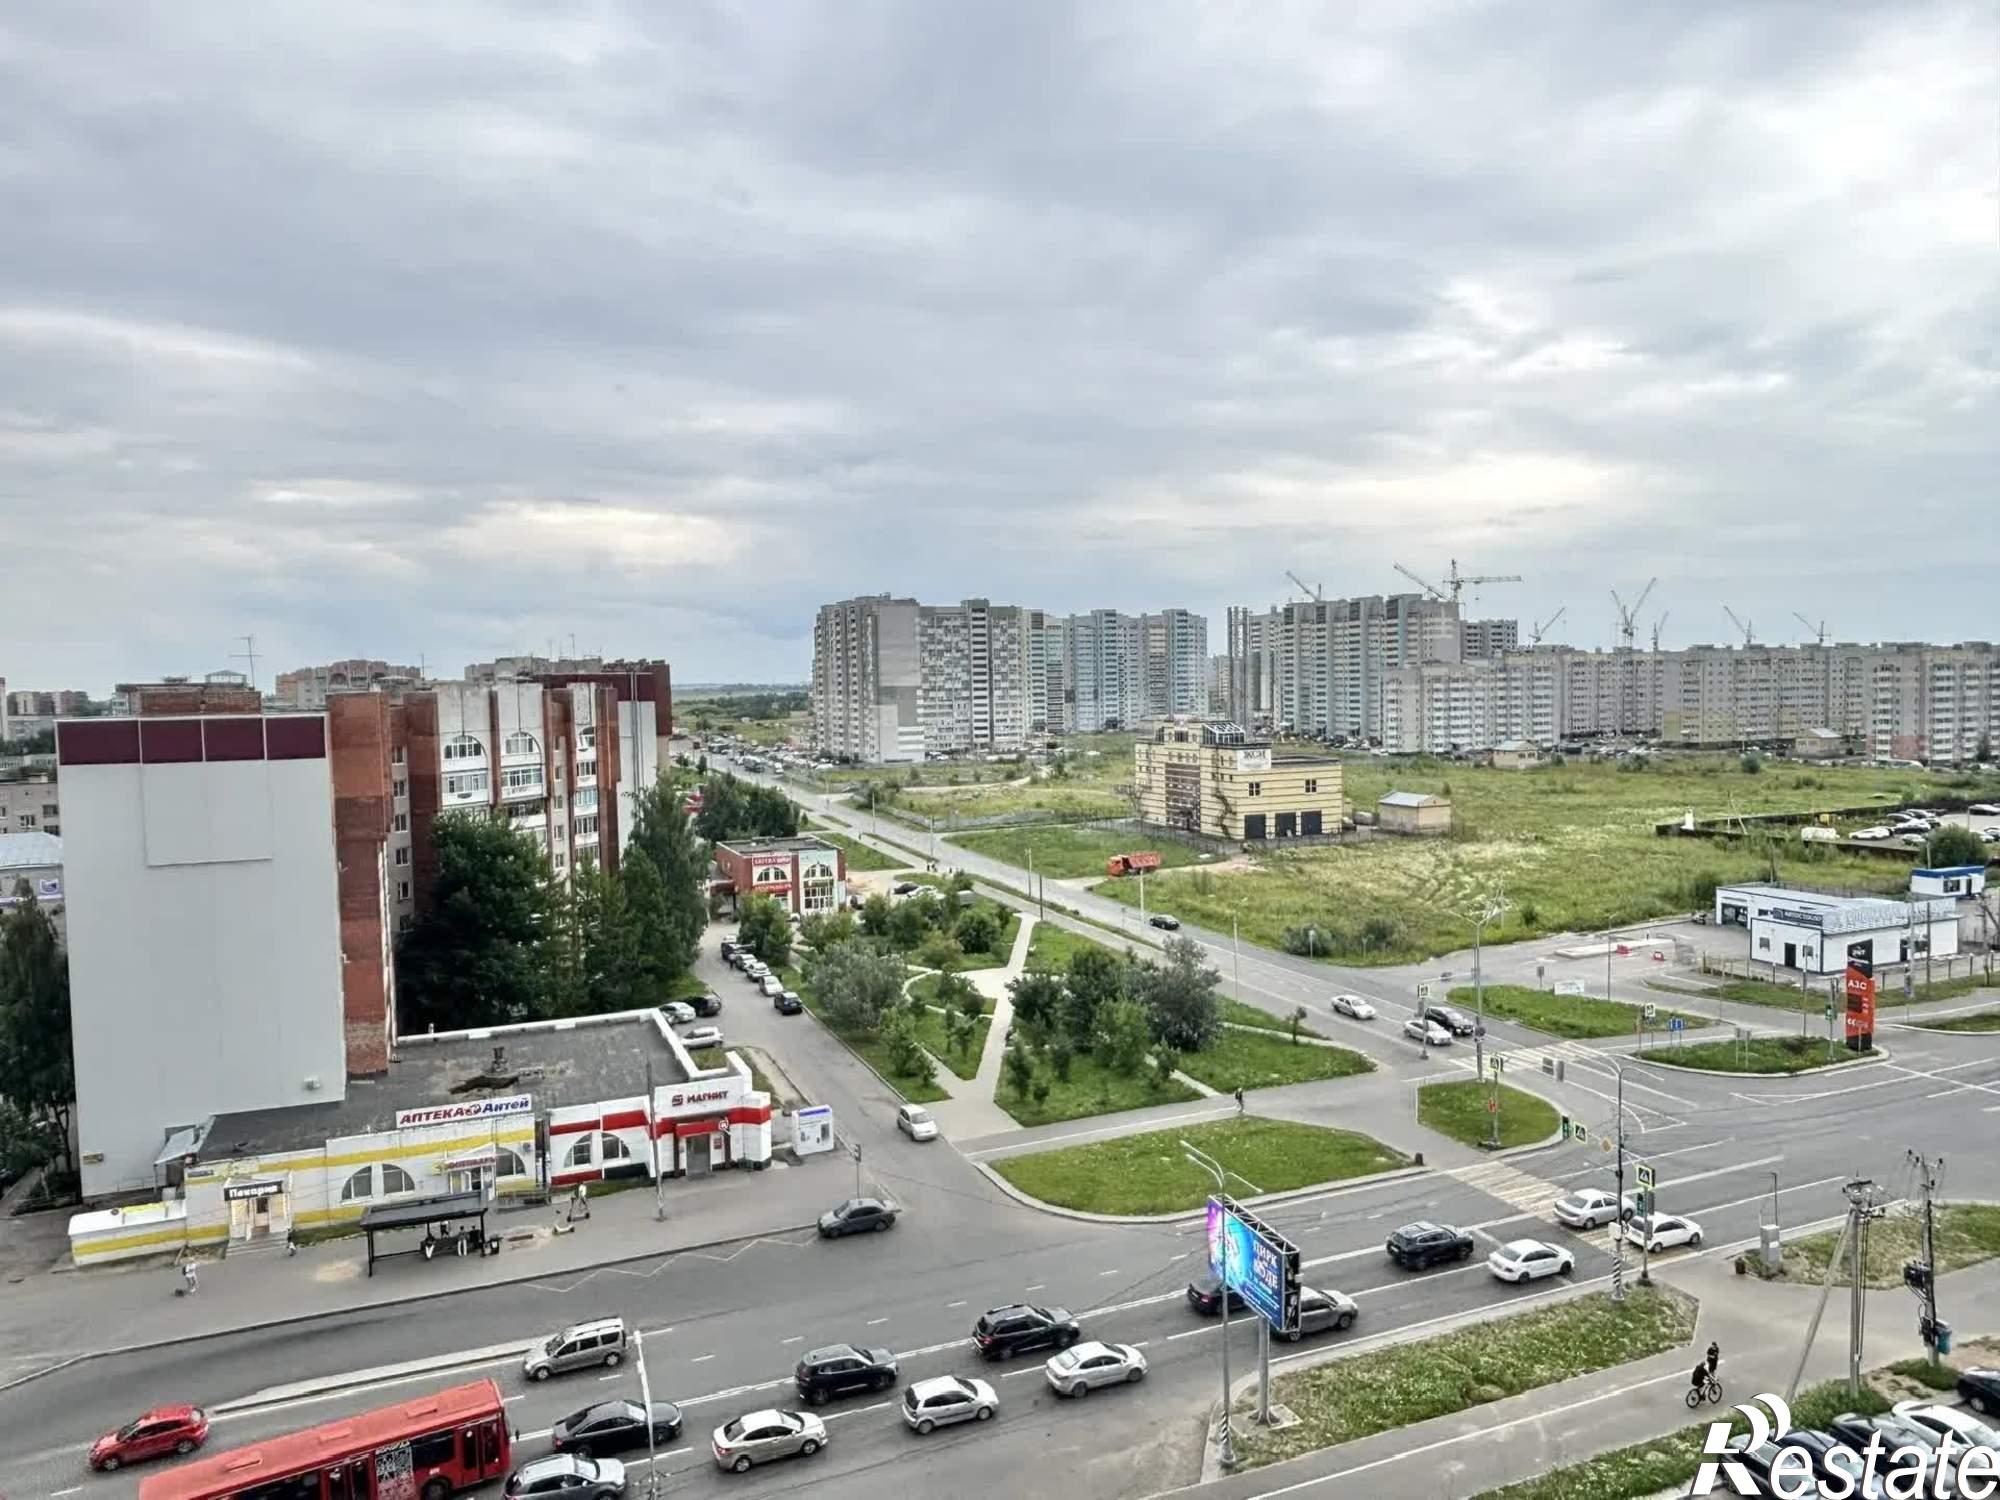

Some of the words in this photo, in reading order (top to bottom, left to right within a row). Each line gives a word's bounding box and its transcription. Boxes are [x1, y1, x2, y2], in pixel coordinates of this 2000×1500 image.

[1847, 979, 1867, 990] АЗС
[687, 1090, 729, 1104] МАГНИТ
[400, 1107, 464, 1125] АПТЕКА
[482, 1097, 529, 1114] Антей
